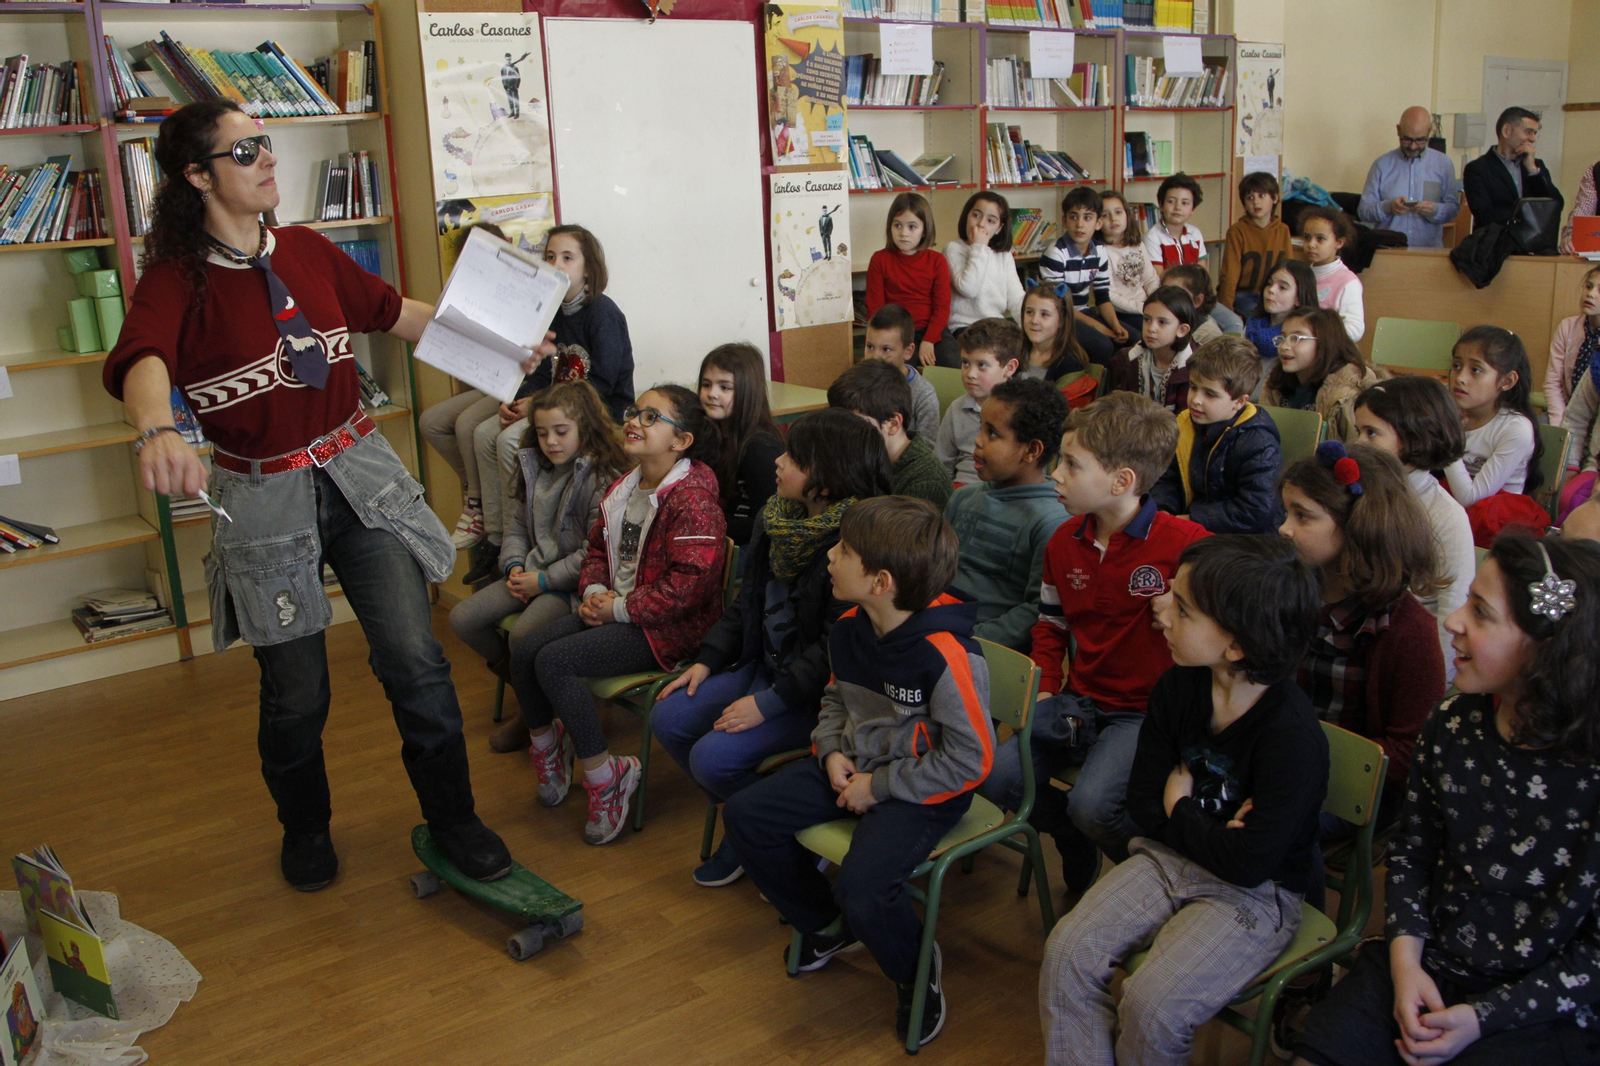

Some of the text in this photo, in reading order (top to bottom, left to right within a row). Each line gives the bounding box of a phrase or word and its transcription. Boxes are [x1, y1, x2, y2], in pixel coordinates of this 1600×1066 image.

[429, 22, 531, 36] Carlos Casares
[1240, 49, 1260, 58] Carlos
[774, 180, 842, 194] Carlos Casares
[491, 206, 514, 216] CARLOS
